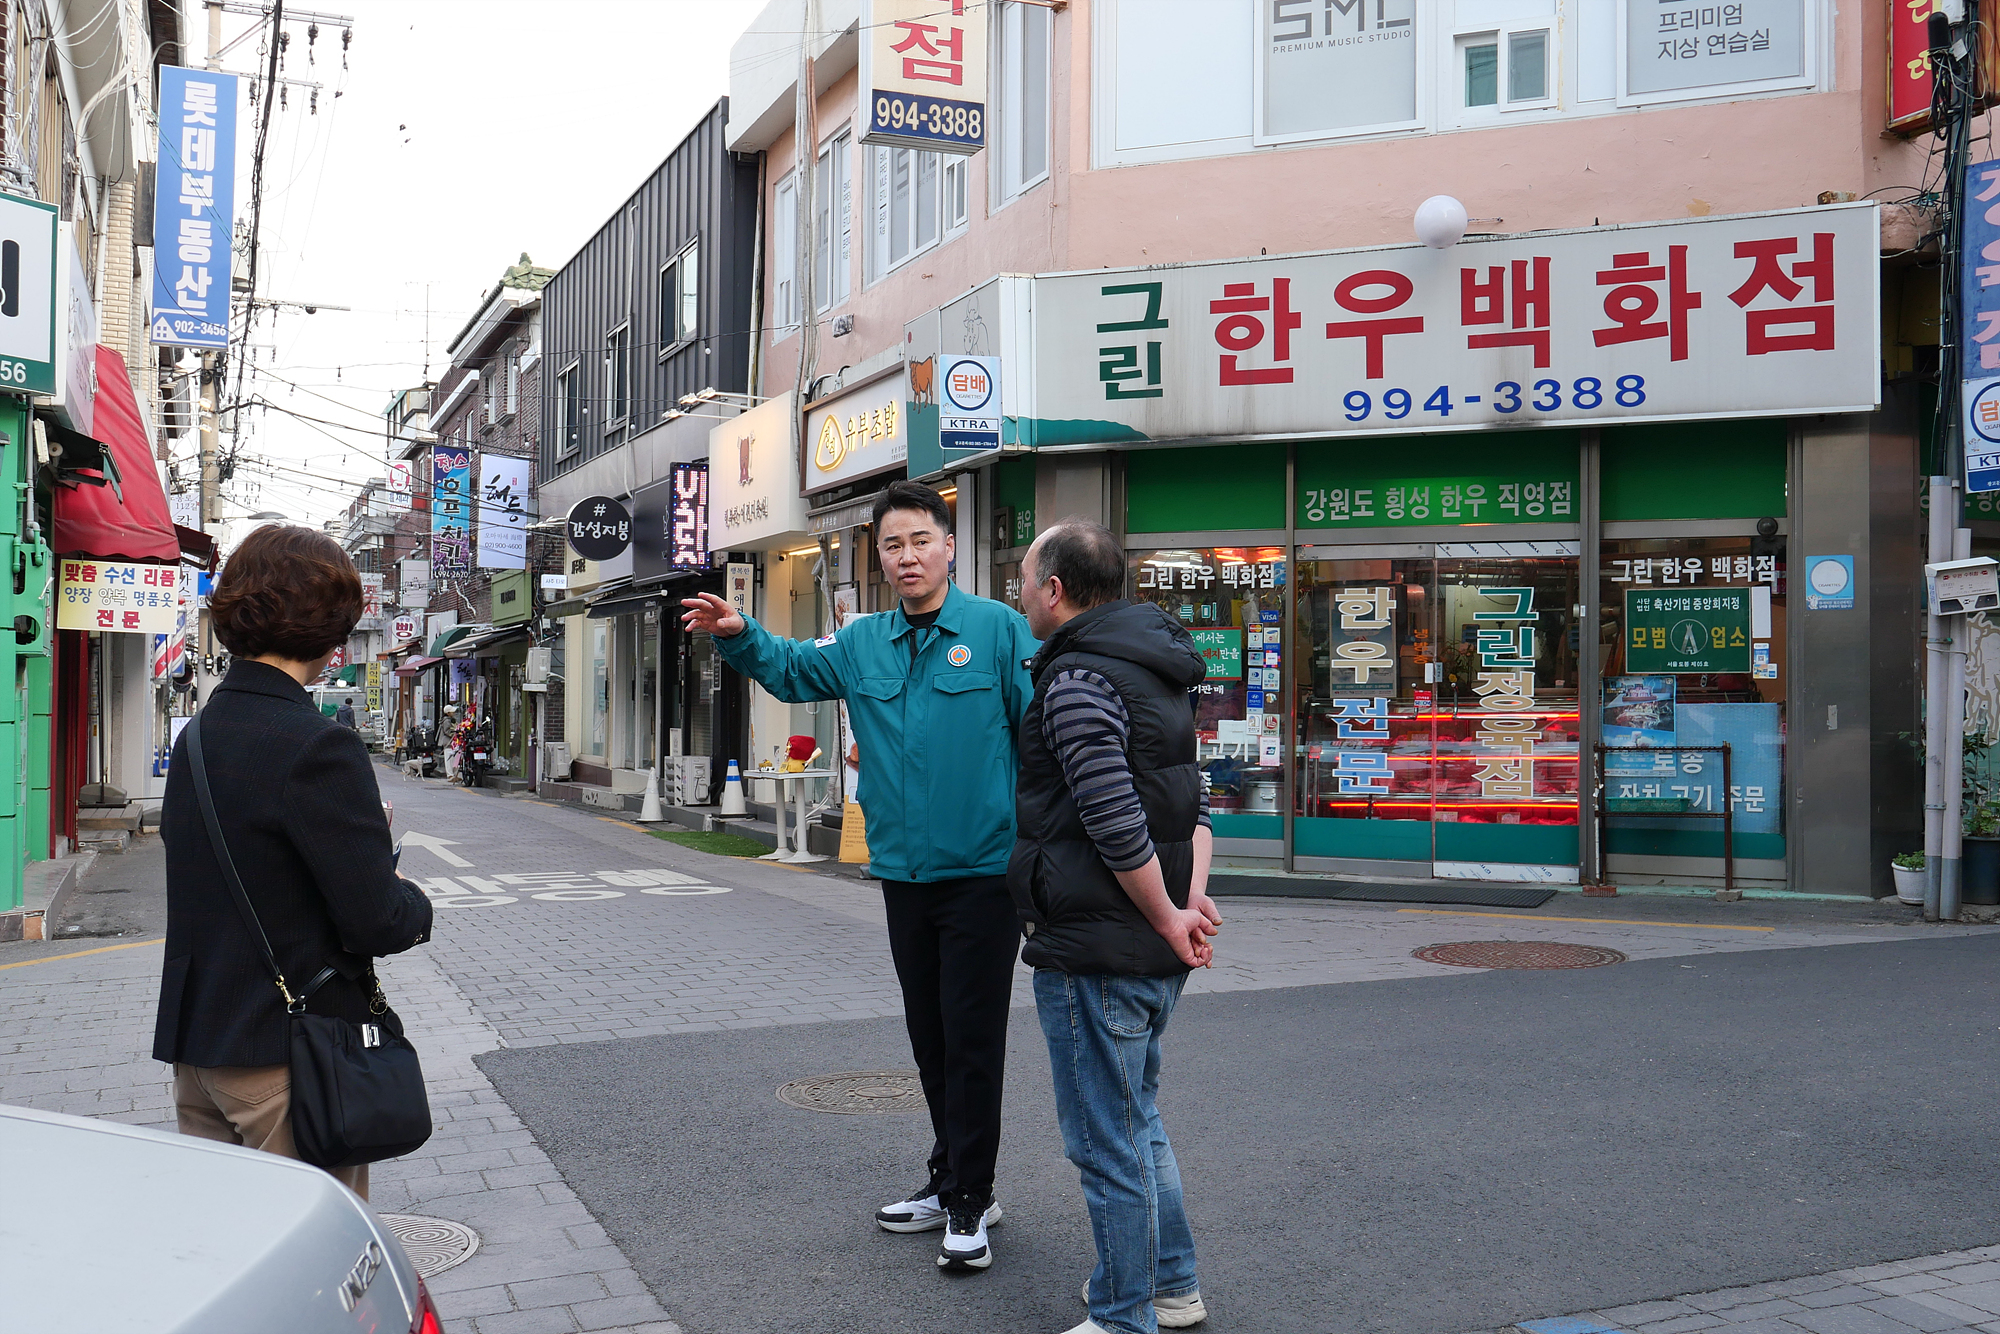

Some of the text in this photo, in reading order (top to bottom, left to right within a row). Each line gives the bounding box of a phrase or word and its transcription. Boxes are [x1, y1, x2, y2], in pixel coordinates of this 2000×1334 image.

[1658, 3, 1743, 33] 프리미엄
[890, 0, 963, 86] 점
[1273, 29, 1411, 54] PREMIUM MUSIC STUDIO
[1658, 28, 1770, 60] 지상 연습실
[876, 97, 982, 139] 994-3388
[174, 80, 217, 317] 롯데부동산
[174, 319, 227, 336] 902-3456
[1096, 281, 1170, 401] 그린
[952, 374, 986, 393] 담배
[1342, 374, 1647, 422] 994-3388
[1979, 399, 2000, 422] 담
[845, 400, 898, 452] 유부초밥
[950, 419, 989, 429] KTRA
[1979, 455, 2000, 467] KT
[1305, 480, 1573, 522] 강원도 횡성 한우 직영점
[569, 520, 629, 541] 감성지붕
[65, 563, 176, 588] 맞춤 수선 리폼
[1139, 563, 1276, 590] 그린 한우 백화점
[1610, 555, 1776, 585] 그린 한우 백화점
[64, 586, 174, 608] 양장 양복 명품옷
[1005, 578, 1020, 600] 국산
[1636, 604, 1650, 612] 법인
[1653, 596, 1741, 612] 축산기업 중앙회지정
[395, 621, 414, 638] 빵
[1331, 586, 1397, 685] 한우
[1413, 628, 1429, 665] 냉방중
[1471, 586, 1543, 798] 그린 정육점
[1331, 696, 1395, 794] 전문
[1670, 784, 1712, 812] 고기
